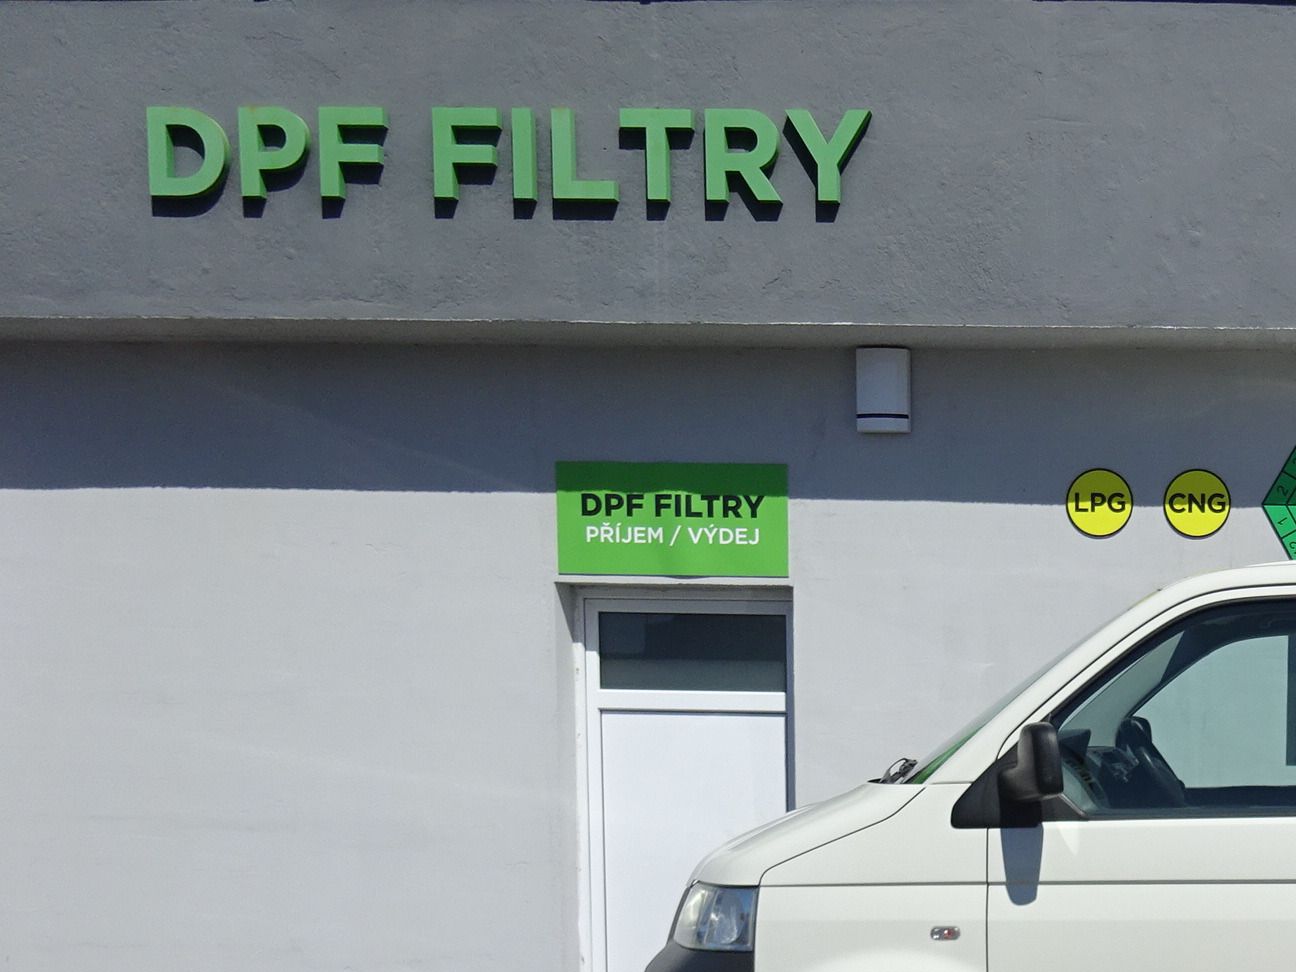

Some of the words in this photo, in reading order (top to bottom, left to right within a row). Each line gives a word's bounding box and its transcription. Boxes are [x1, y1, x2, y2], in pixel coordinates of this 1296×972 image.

[146, 106, 388, 200] DPF
[431, 107, 872, 204] FILTRY
[1276, 485, 1288, 496] 2
[581, 493, 645, 517] DPF
[655, 494, 765, 518] FILTRY
[1074, 492, 1126, 513] LPG
[1168, 493, 1226, 514] CNG
[1277, 517, 1288, 525] 1
[586, 522, 664, 543] PŘÍJEM
[669, 525, 681, 546] /
[688, 524, 760, 545] VÝDEJ
